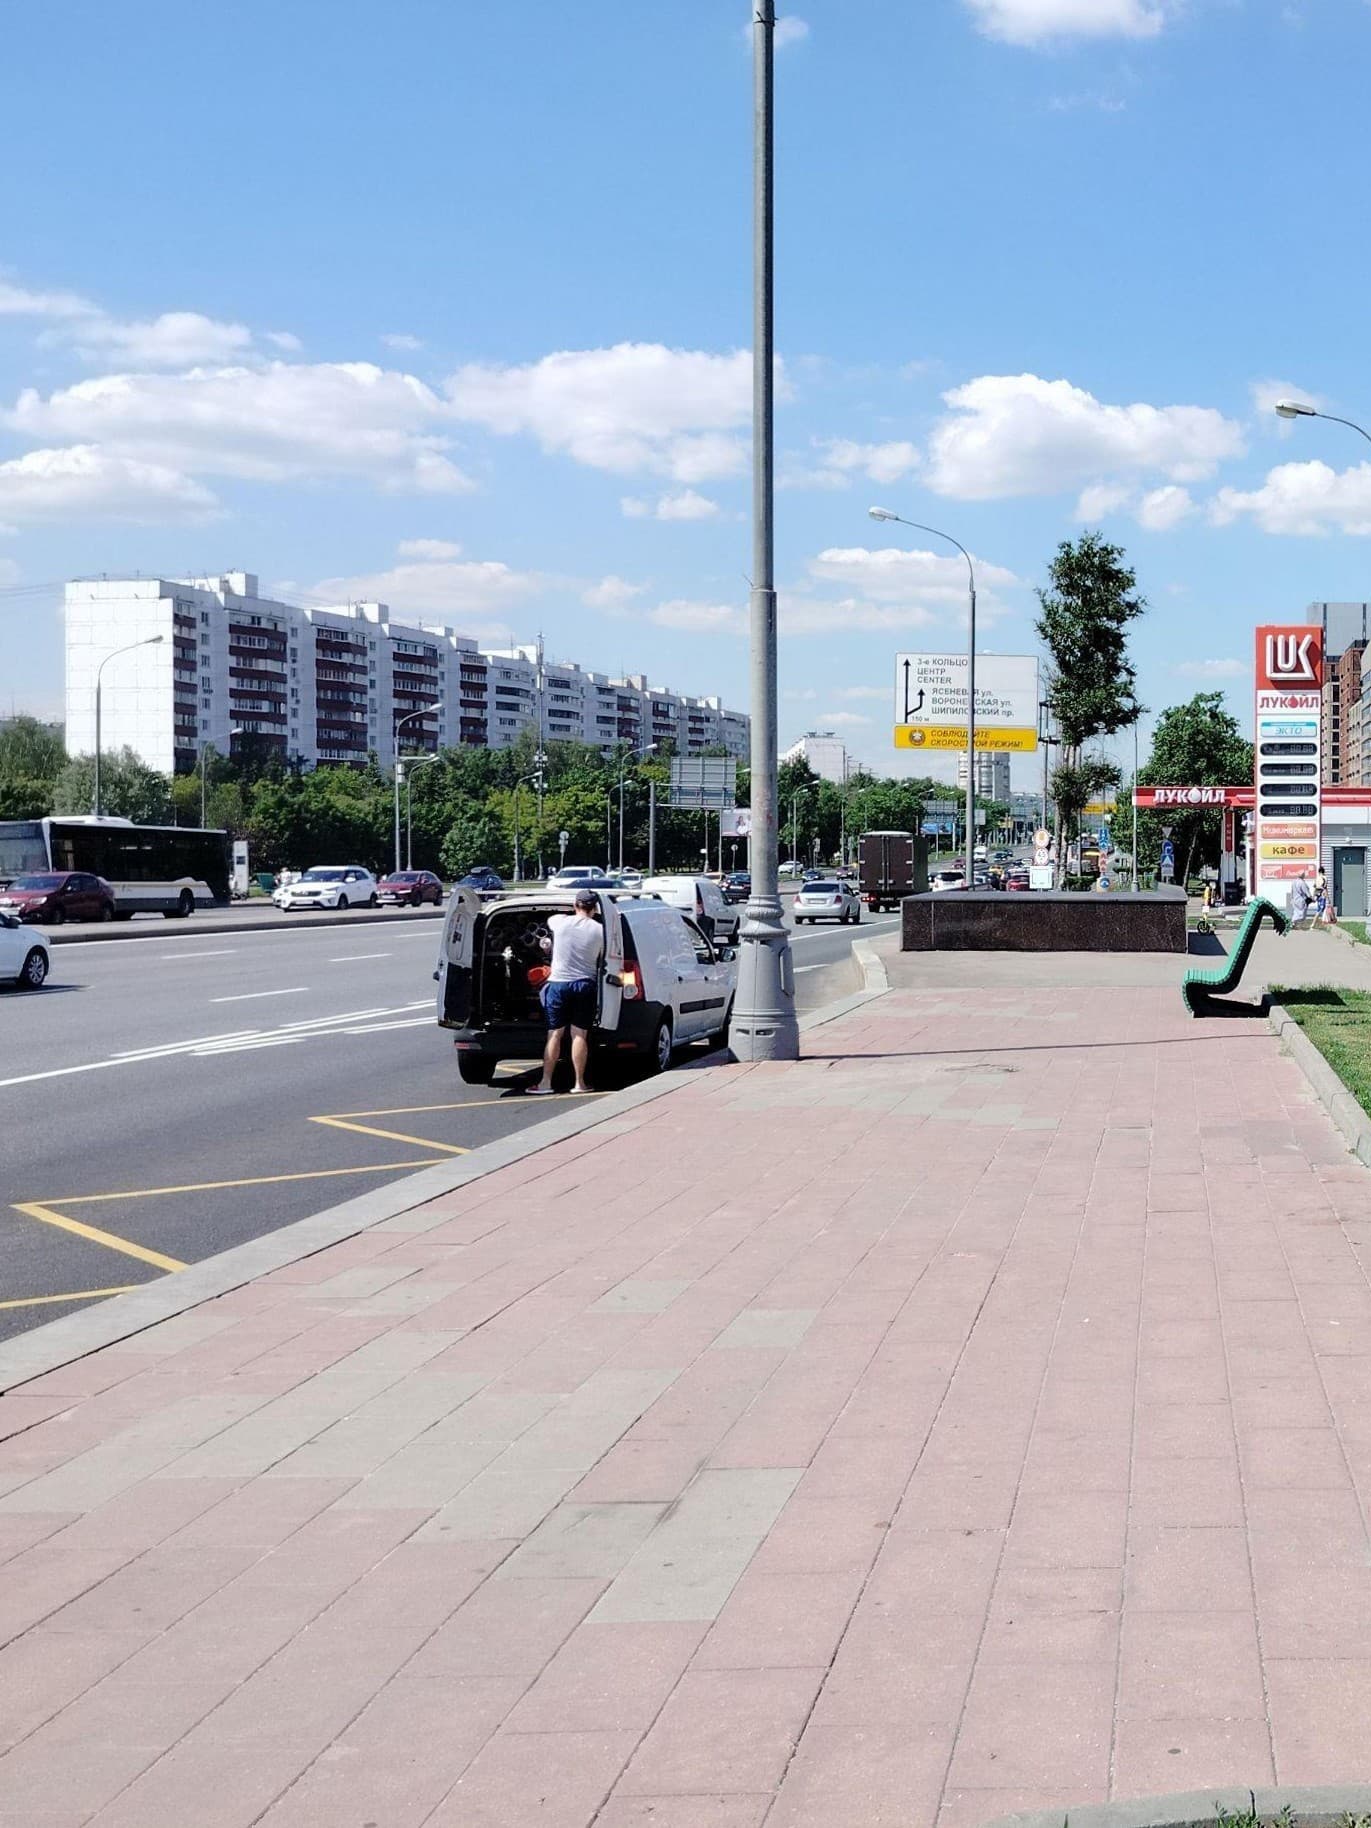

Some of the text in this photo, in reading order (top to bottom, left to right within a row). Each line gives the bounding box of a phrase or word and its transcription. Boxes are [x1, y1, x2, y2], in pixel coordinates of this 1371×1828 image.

[932, 658, 968, 667] КОЛЬЦО
[917, 668, 946, 676] ЦЕНТР
[917, 676, 952, 684] CENTER
[932, 688, 980, 696] ЯСЕНЕВЯ
[932, 697, 998, 706] ВОРОНЕСКАЯ
[931, 730, 990, 738] СОБЛЮДЙТЕ
[931, 739, 988, 748] СКОРОСТОЙ
[1272, 846, 1305, 855] кафе
